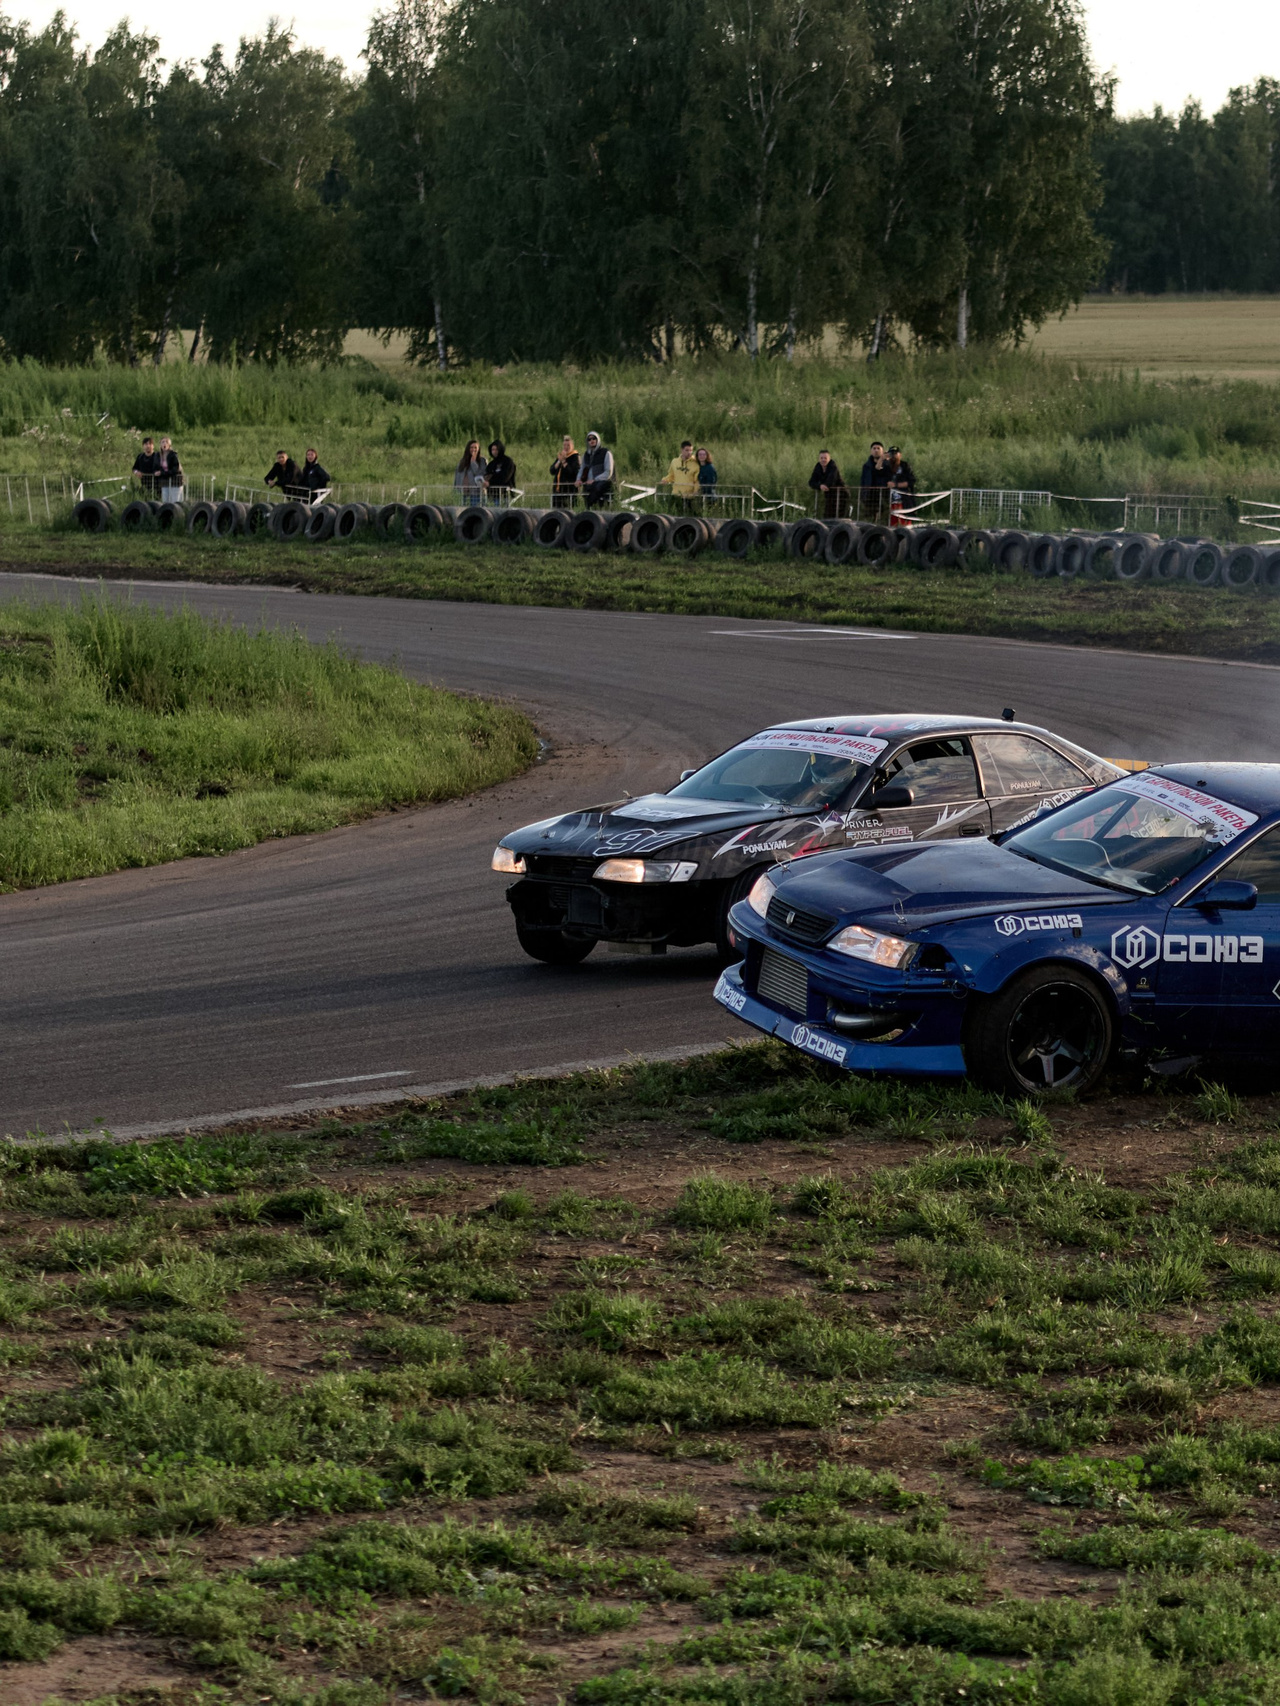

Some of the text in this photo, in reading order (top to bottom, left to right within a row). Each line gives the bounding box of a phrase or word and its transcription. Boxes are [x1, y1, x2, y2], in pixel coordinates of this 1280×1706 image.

[840, 739, 884, 754] РАКЕТЫ
[854, 751, 875, 761] 2025
[592, 828, 703, 857] 97
[742, 840, 788, 855] PONULYAM
[1024, 914, 1083, 931] СОЮЗ
[1163, 934, 1264, 963] СОЮЗ
[806, 1033, 847, 1062] СОЮЗ
